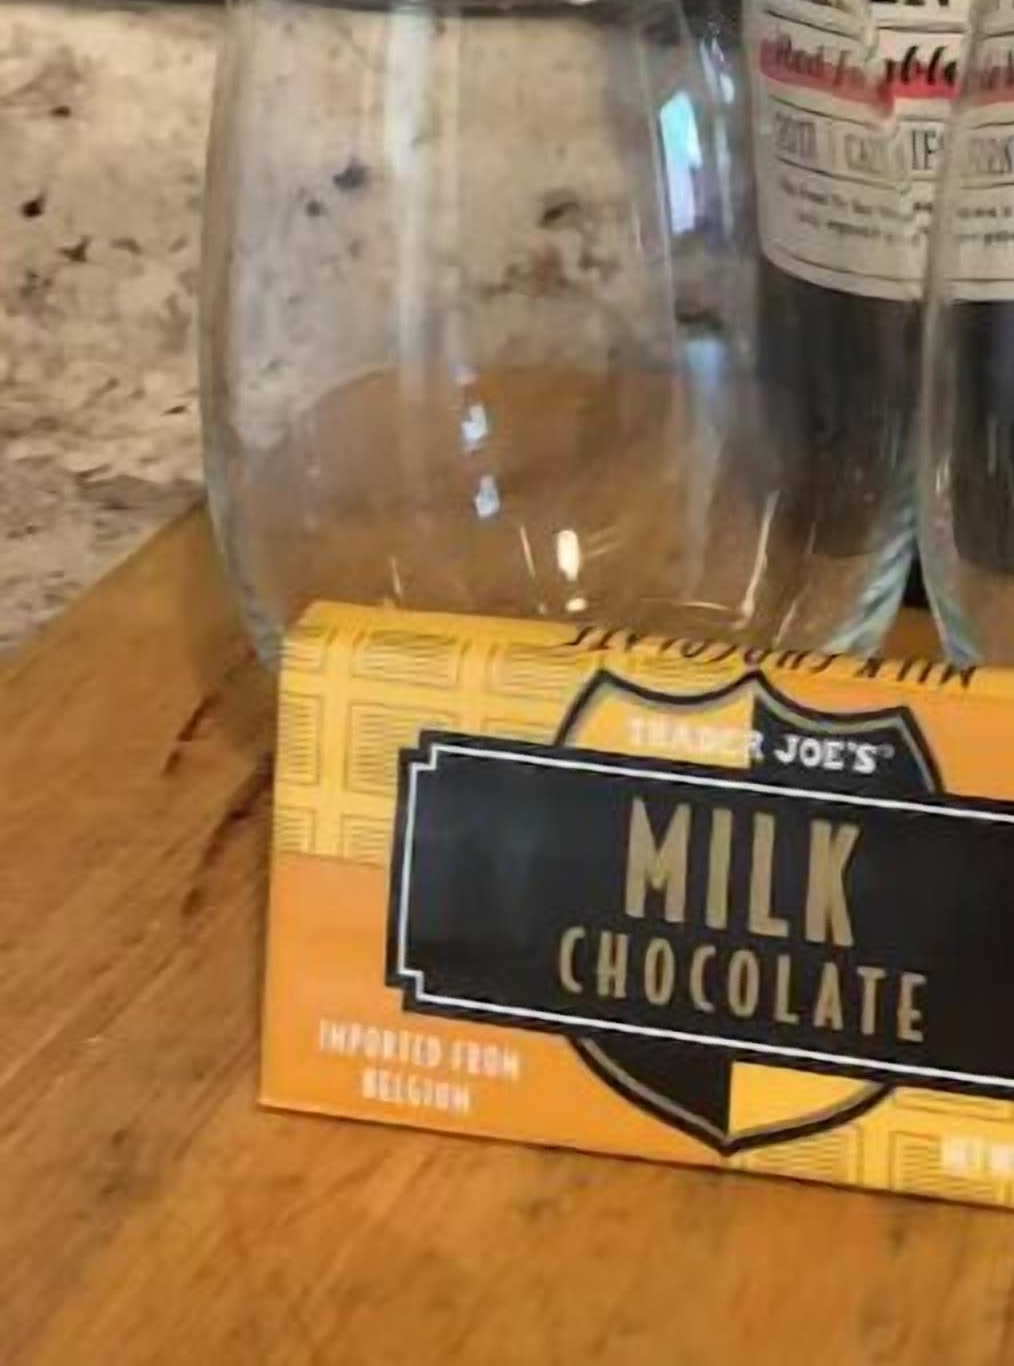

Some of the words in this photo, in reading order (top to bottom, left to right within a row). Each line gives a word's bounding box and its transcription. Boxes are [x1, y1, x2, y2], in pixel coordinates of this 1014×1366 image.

[629, 713, 766, 763] TRADER
[774, 733, 879, 775] JOE'S
[624, 796, 861, 948] MILK
[557, 925, 928, 1044] CHOCOLATE
[319, 1018, 443, 1068] IMPORTED
[450, 1040, 521, 1083] FROM
[361, 1066, 470, 1117] BELGIUM
